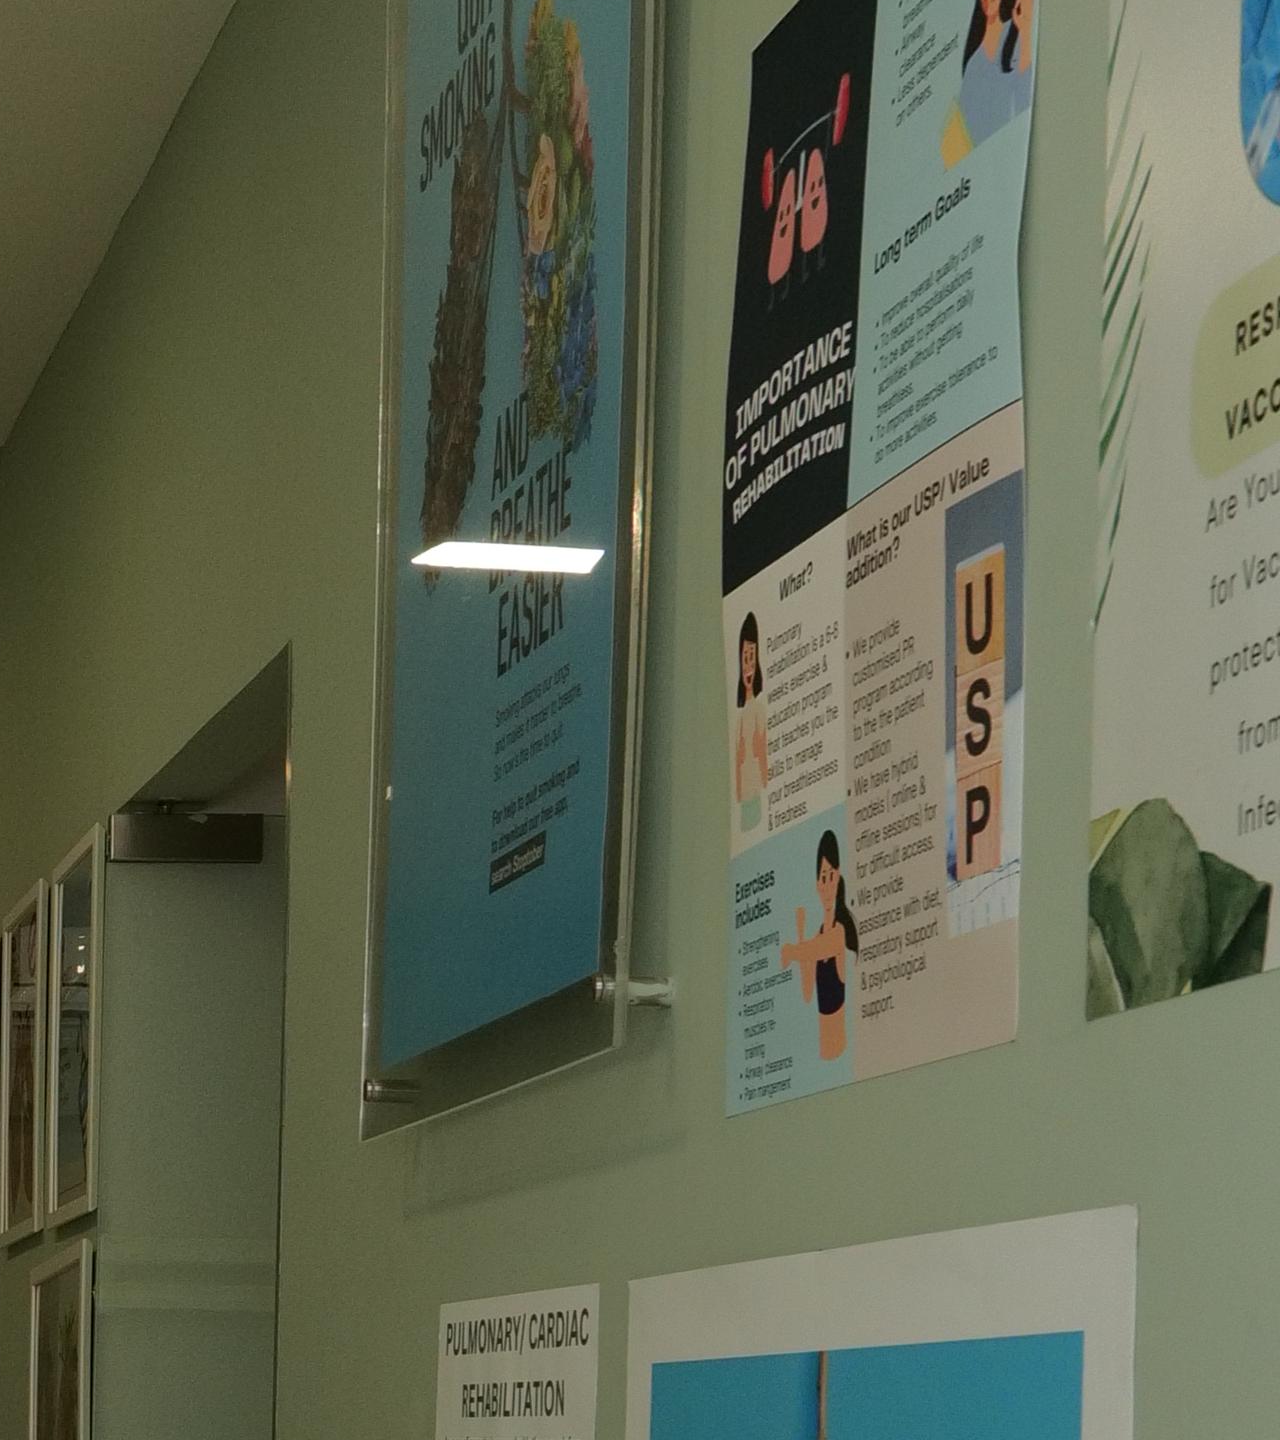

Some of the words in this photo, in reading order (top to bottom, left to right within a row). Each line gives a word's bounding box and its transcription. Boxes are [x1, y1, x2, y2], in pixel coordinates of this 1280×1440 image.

[419, 14, 495, 198] SMOKING
[873, 237, 901, 274] Long
[903, 211, 931, 247] term
[934, 177, 970, 221] Goals
[1235, 295, 1280, 354] RES
[735, 320, 852, 439] IMPORTANCE
[491, 388, 528, 501] AND
[724, 442, 747, 490] OF
[749, 353, 857, 466] PULMONARY
[732, 422, 845, 524] REHABILITATION
[846, 525, 877, 560] What
[879, 518, 888, 539] is
[891, 503, 911, 531] our
[948, 457, 989, 494] Value
[1206, 494, 1237, 531] Are
[779, 560, 813, 601] What?
[845, 535, 899, 588] addition?
[1209, 572, 1237, 607] for
[497, 574, 563, 677] EASIER
[766, 623, 801, 654] Pulmonary
[852, 638, 867, 658] We
[868, 619, 900, 653] provide
[766, 642, 810, 678] rehabilitation
[811, 637, 818, 652] is
[818, 633, 824, 648] a
[789, 662, 820, 691] exercise
[852, 647, 900, 687] customised
[902, 635, 914, 652] PR
[766, 700, 800, 730] education
[801, 682, 832, 711] program
[852, 683, 887, 718] program
[888, 659, 933, 695] according
[852, 724, 862, 742] to
[863, 717, 877, 736] the
[878, 709, 892, 728] the
[893, 688, 925, 724] patient
[794, 740, 823, 763] manage
[853, 738, 891, 770] condition
[735, 869, 775, 903] Exercises
[445, 1313, 526, 1355] PULMONARY/
[528, 1307, 589, 1349] CARDIAC
[461, 1379, 564, 1418] REHABILITATION
